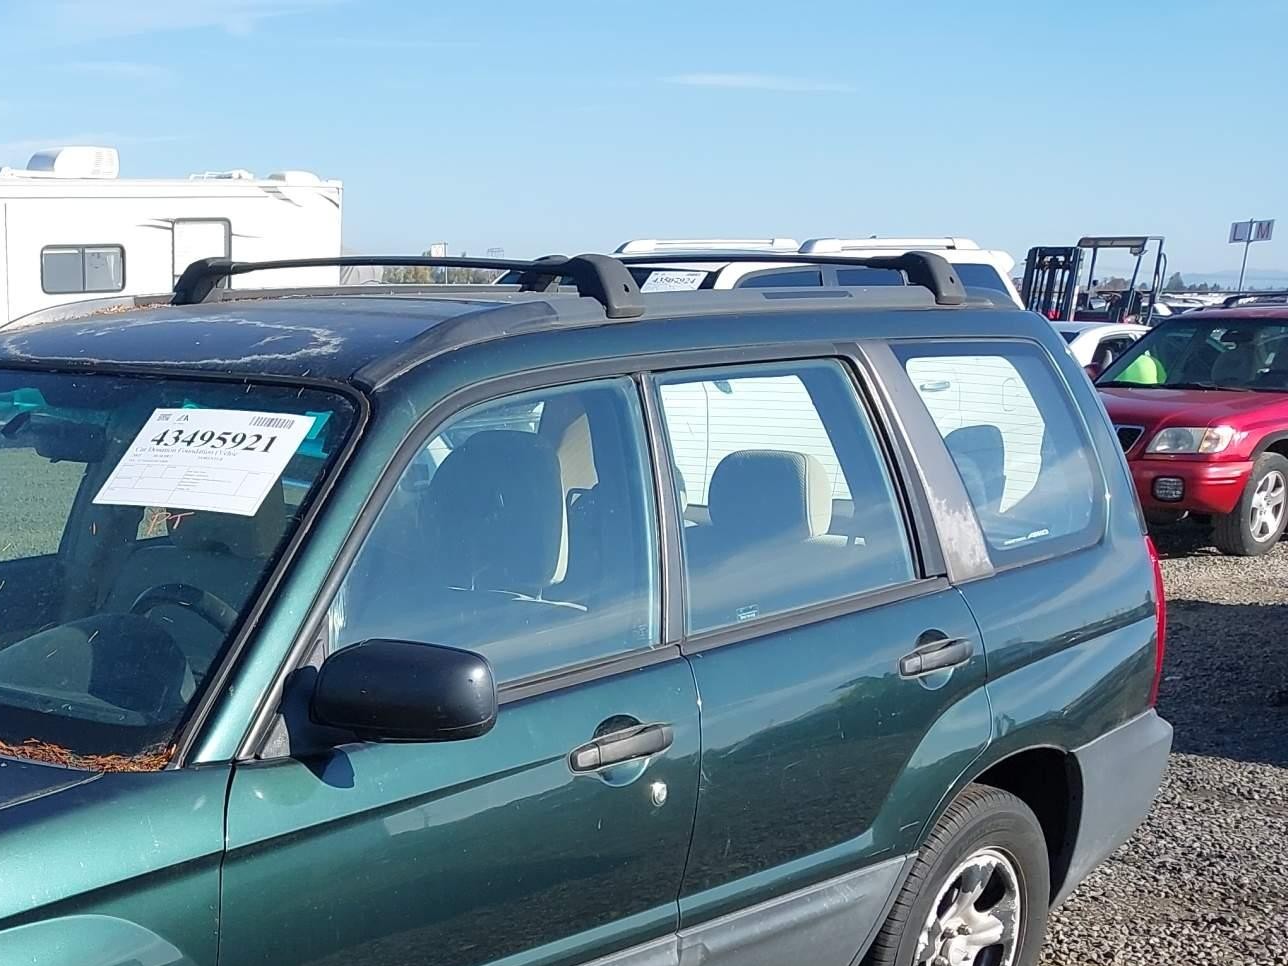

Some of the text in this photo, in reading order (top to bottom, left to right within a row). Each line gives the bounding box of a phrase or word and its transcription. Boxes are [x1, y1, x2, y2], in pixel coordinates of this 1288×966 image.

[1233, 224, 1243, 241] L
[1257, 222, 1271, 239] M
[151, 429, 278, 453] 43495921
[147, 511, 195, 536] PT
